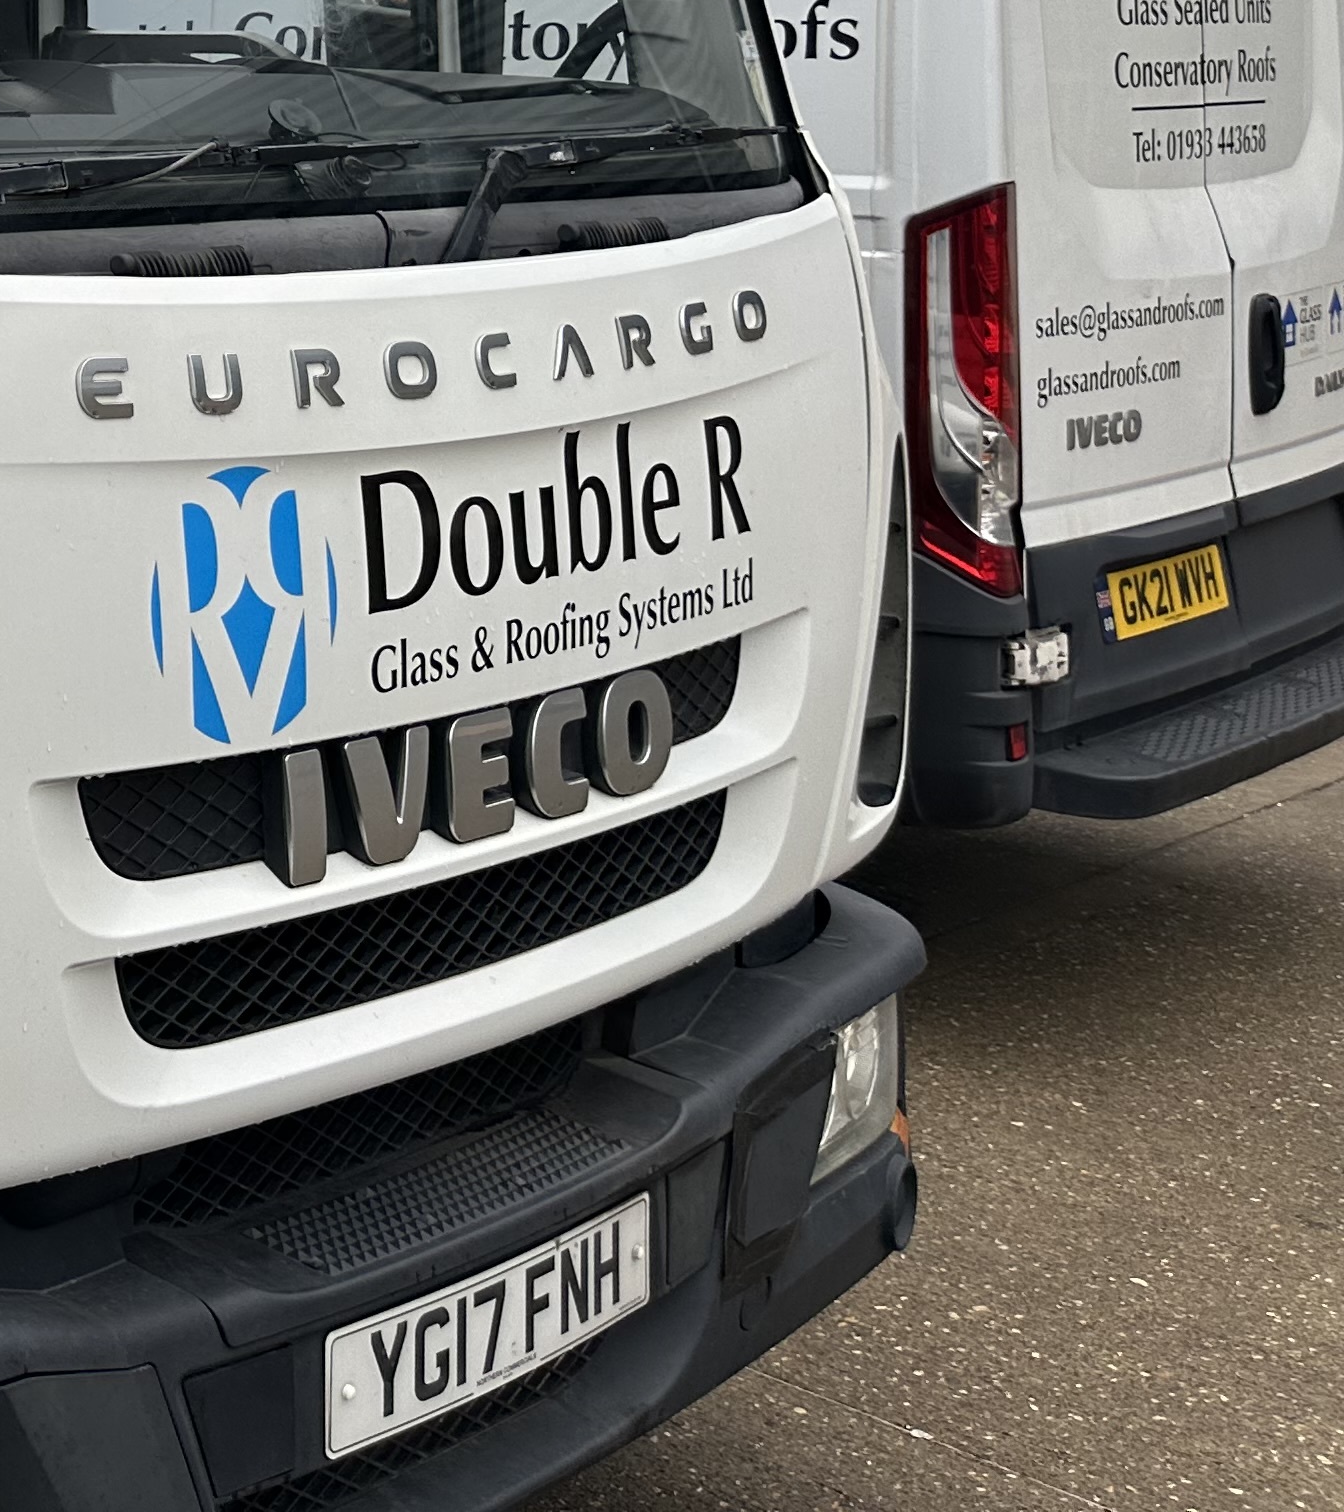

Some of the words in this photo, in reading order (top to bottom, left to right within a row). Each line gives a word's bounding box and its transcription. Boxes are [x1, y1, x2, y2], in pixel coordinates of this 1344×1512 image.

[1114, 51, 1234, 97] Conservatory
[1237, 45, 1277, 84] Roofs
[1132, 128, 1162, 163] Tel:
[1166, 127, 1213, 162] 01933
[1217, 123, 1267, 155] 443658
[75, 288, 768, 420] EUROCARGO
[1035, 293, 1225, 342] sales@glassandroofs.com
[1037, 355, 1181, 409] glassandroofs.com
[1066, 408, 1143, 451] IVECO
[360, 422, 681, 615] Double
[703, 415, 753, 542] R
[370, 637, 460, 694] Glass
[470, 625, 495, 674] &
[505, 602, 611, 659] Roofing
[618, 583, 714, 650] Systems
[722, 557, 754, 610] Ltd
[1118, 566, 1175, 626] GK21
[1173, 551, 1220, 609] WVH
[283, 667, 674, 888] IVECO
[370, 1278, 507, 1418] YG17
[524, 1220, 621, 1354] FNH
